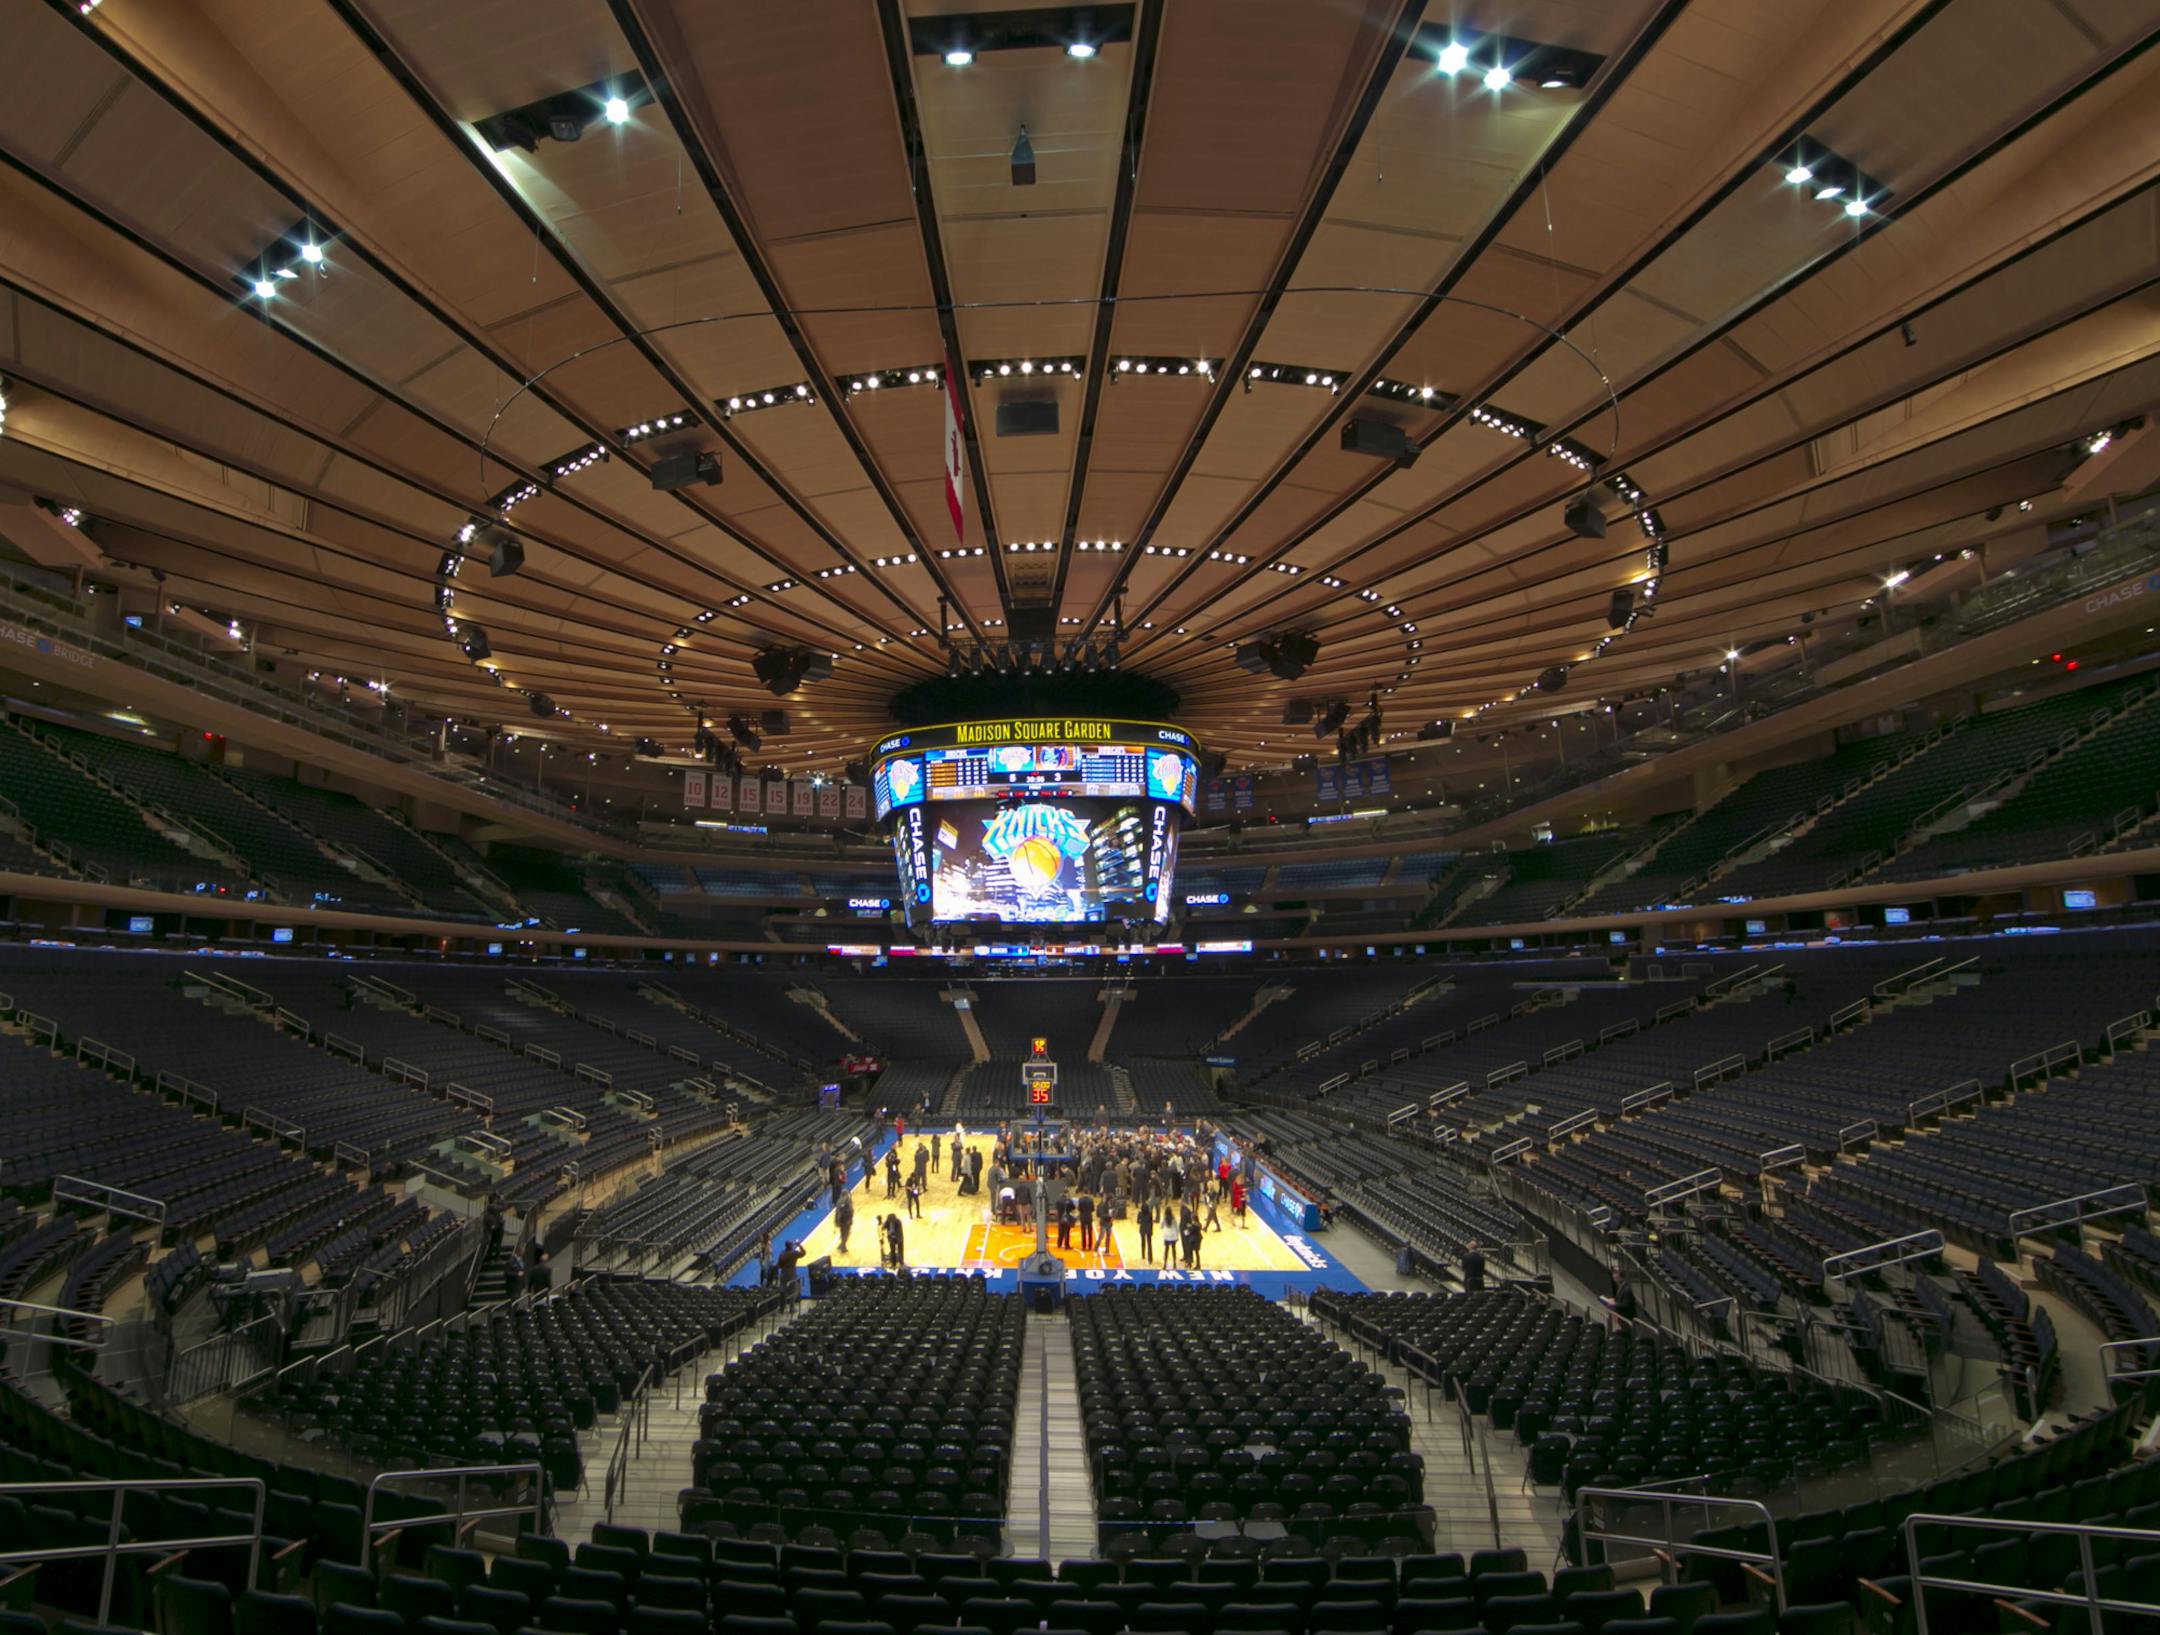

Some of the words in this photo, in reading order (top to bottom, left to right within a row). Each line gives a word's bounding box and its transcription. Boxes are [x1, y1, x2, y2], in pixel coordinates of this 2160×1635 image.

[2085, 581, 2145, 613] CHASE
[53, 645, 95, 669] BRIDGE
[1158, 730, 1185, 743] CHASE
[688, 782, 702, 795] 10
[715, 785, 728, 799] 12
[743, 788, 757, 802] 15
[771, 791, 784, 803] 15
[797, 792, 810, 805] 19
[822, 793, 838, 807] 22
[848, 795, 864, 809] 24
[982, 804, 1090, 848] KNICKS
[909, 807, 928, 881] CHASE
[1148, 805, 1166, 880] CHASE
[848, 899, 881, 908] CHASE
[1186, 895, 1219, 904] CHASE
[1032, 1088, 1049, 1102] 35
[1158, 1270, 1235, 1281] NEW
